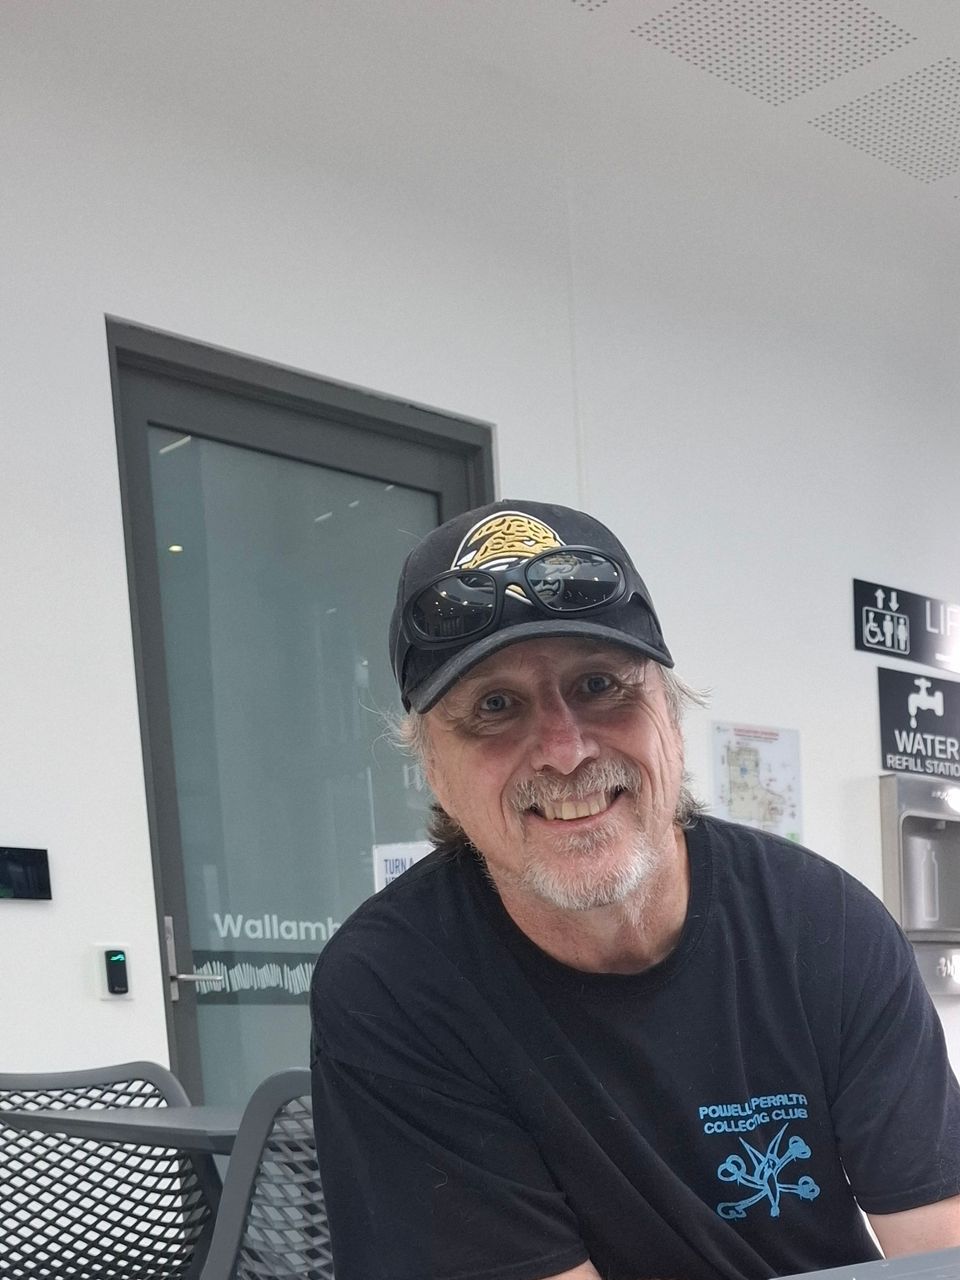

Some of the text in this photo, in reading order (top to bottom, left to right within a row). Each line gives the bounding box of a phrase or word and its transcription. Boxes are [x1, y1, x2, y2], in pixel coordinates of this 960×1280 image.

[894, 729, 960, 761] WATER
[886, 754, 924, 772] REFILL
[384, 858, 407, 875] TURN
[698, 1093, 808, 1120] POWELL PERALTA
[772, 1108, 809, 1121] CLUB
